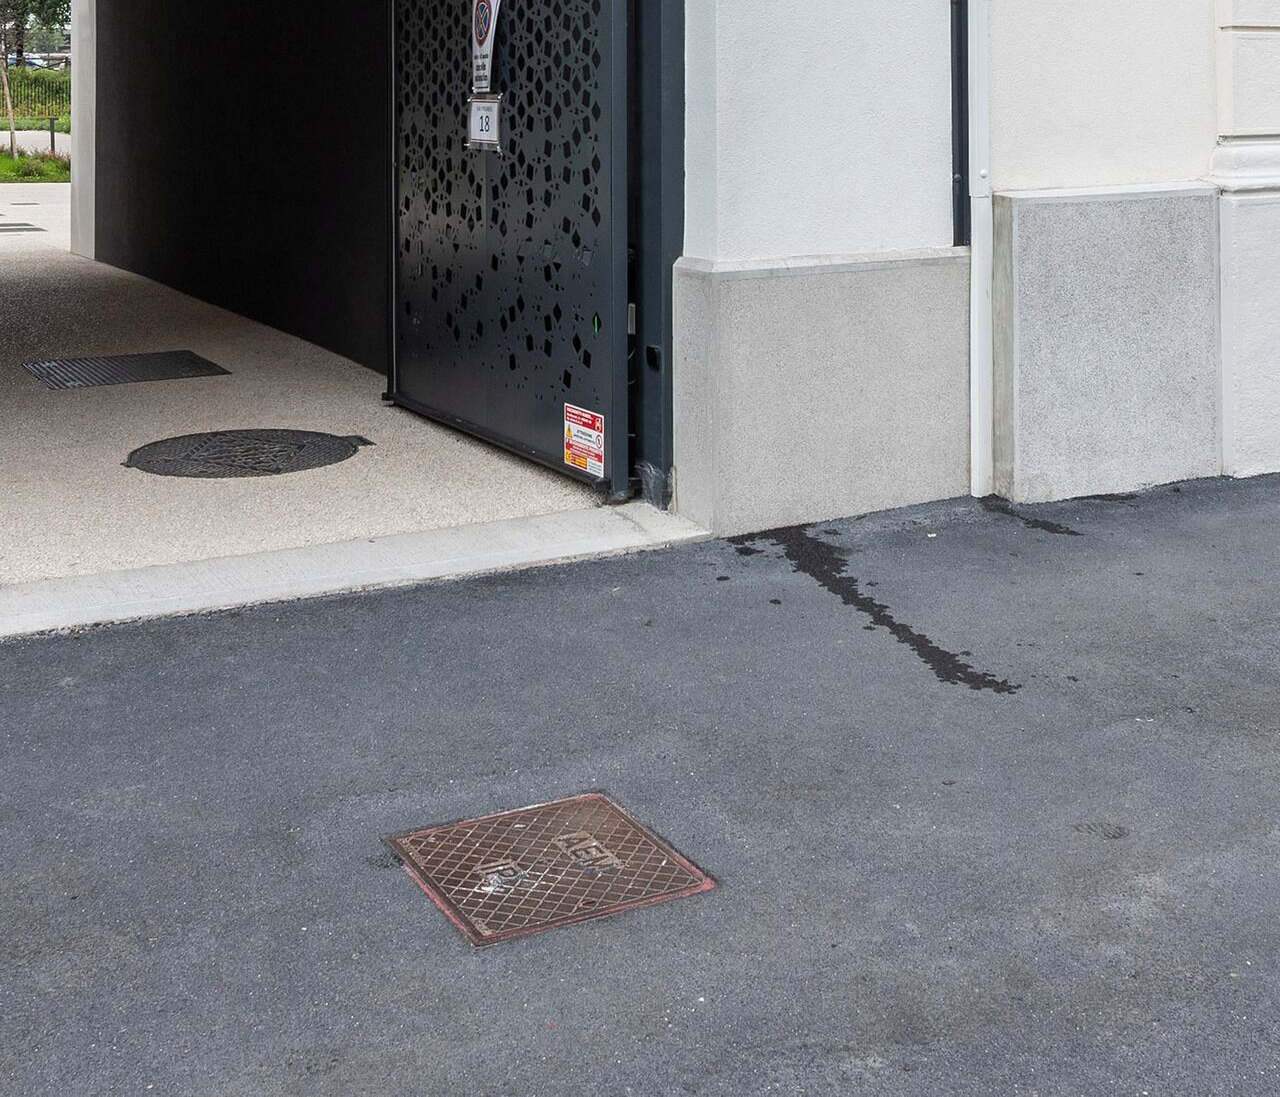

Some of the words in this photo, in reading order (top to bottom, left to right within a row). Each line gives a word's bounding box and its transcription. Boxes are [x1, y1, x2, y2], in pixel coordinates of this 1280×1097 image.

[479, 115, 490, 132] 18
[555, 833, 619, 872] AEM
[479, 861, 522, 882] IP
